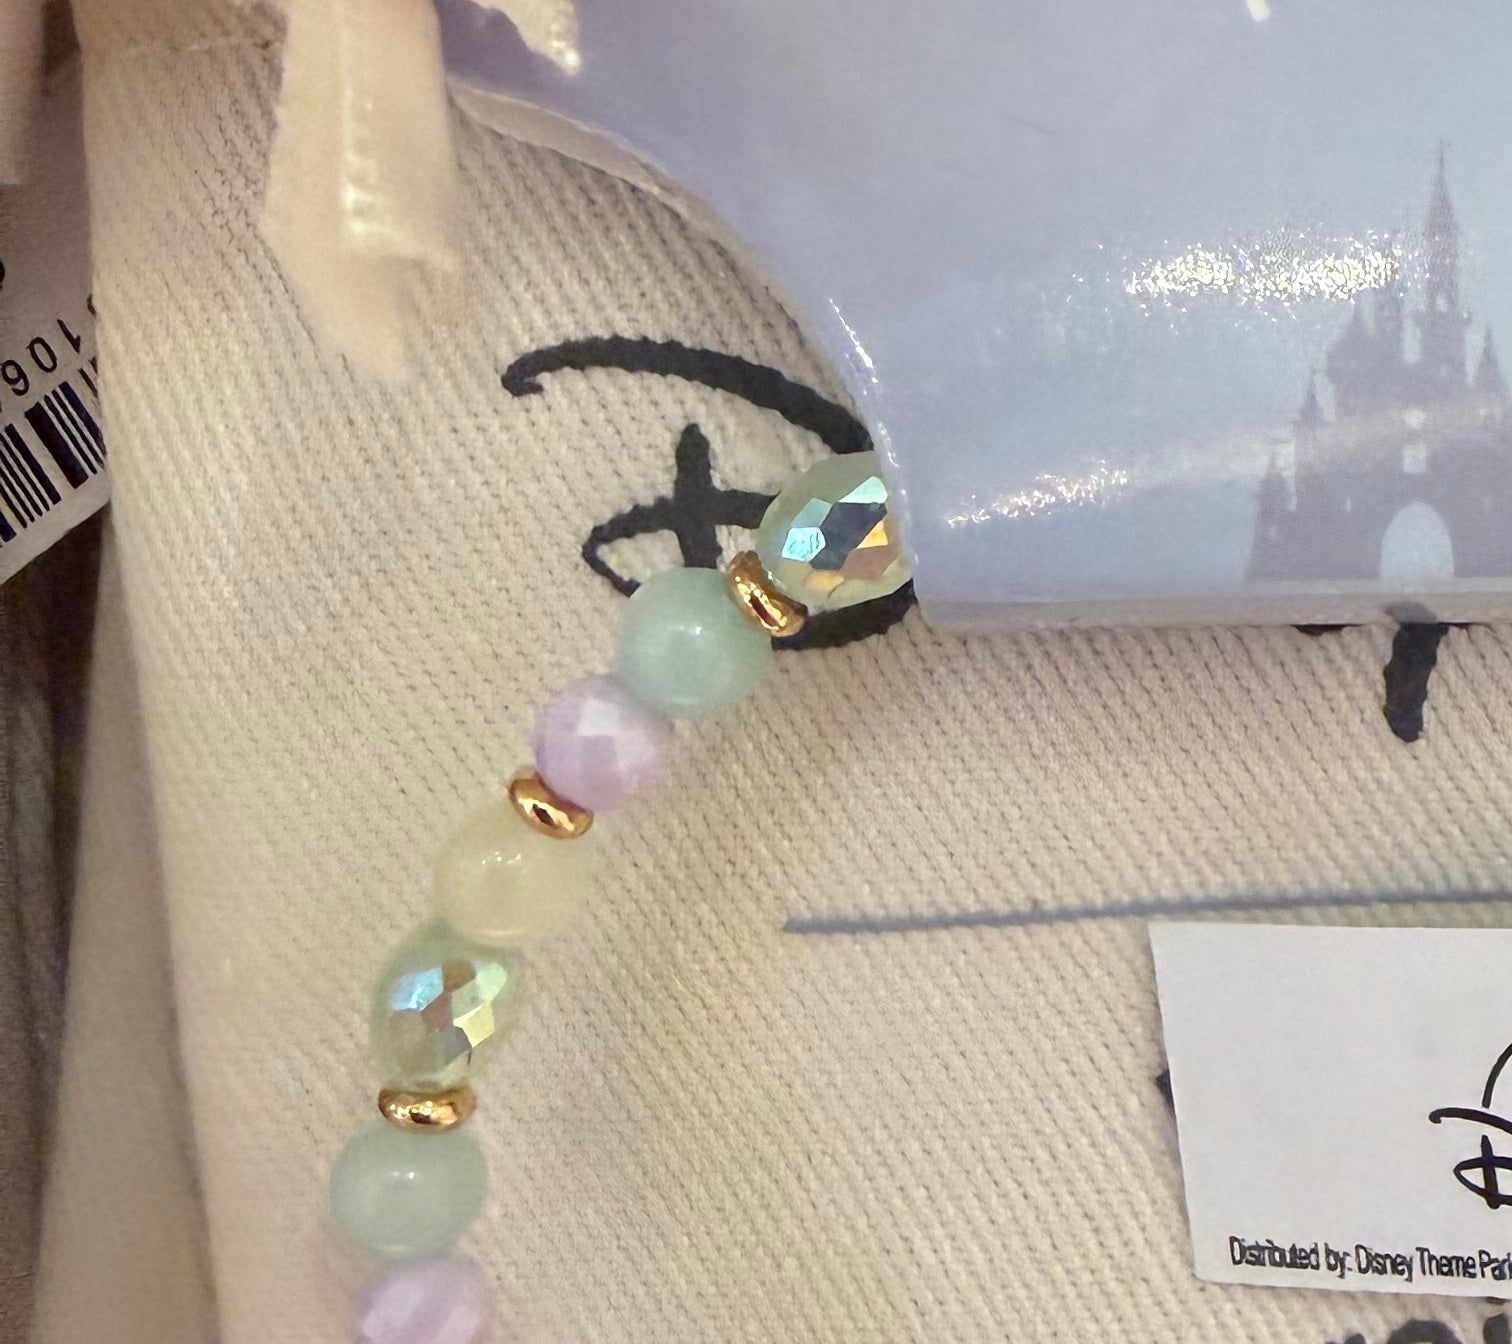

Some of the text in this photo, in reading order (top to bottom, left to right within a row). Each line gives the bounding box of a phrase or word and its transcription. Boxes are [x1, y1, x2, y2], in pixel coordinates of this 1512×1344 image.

[1228, 1235, 1320, 1271] Distributed
[1324, 1242, 1352, 1279] by:
[1354, 1243, 1414, 1282] Disney
[1415, 1246, 1477, 1278] Theme
